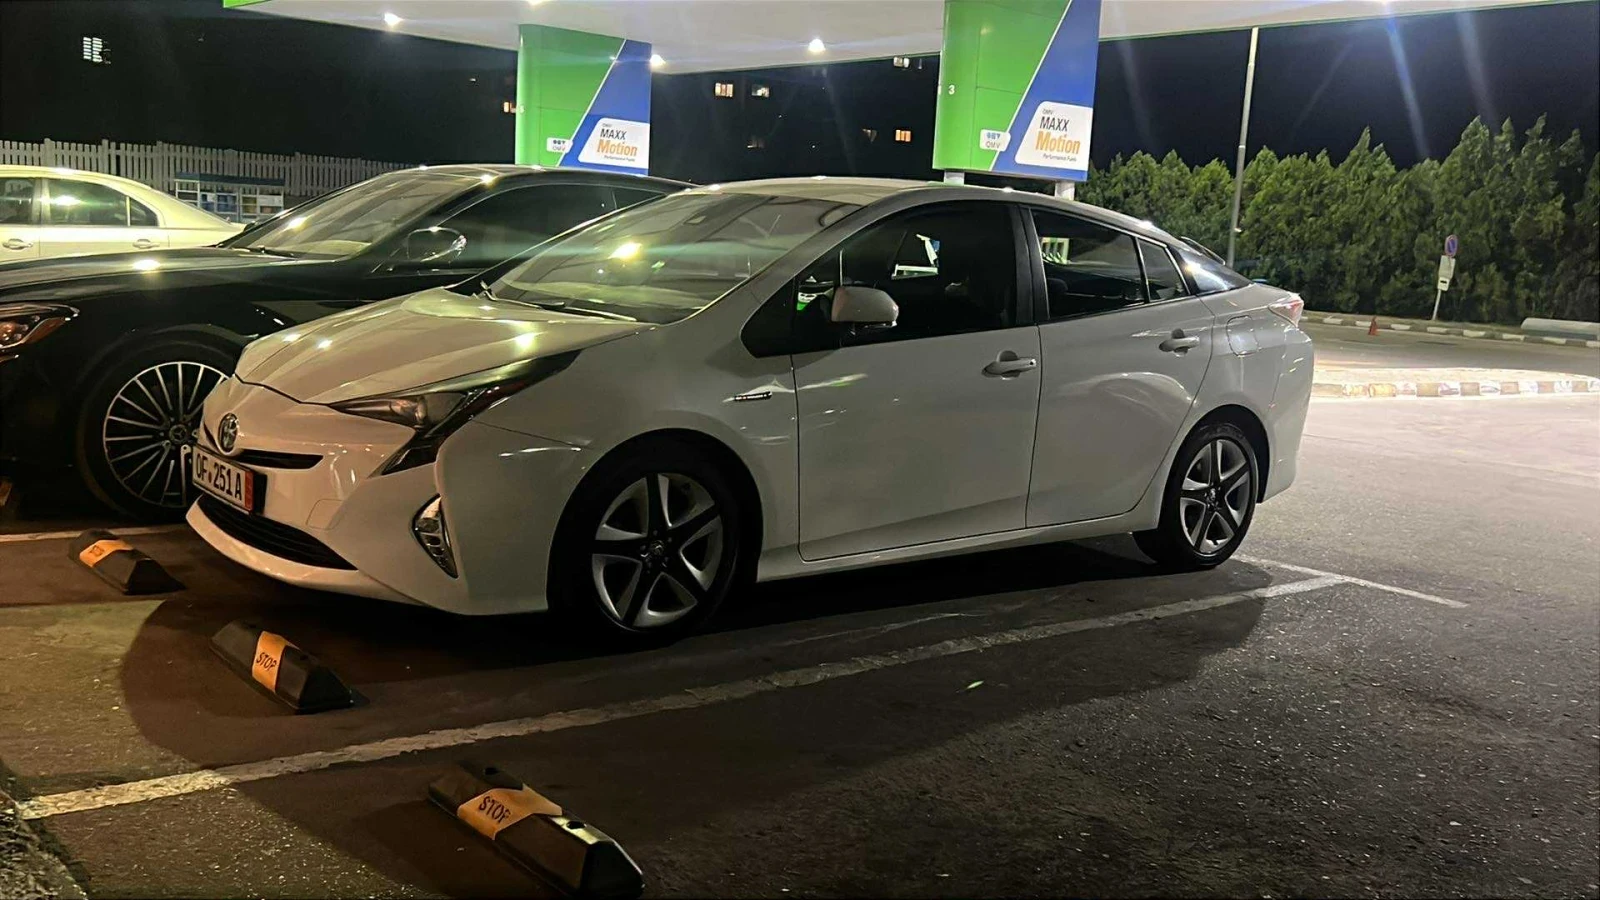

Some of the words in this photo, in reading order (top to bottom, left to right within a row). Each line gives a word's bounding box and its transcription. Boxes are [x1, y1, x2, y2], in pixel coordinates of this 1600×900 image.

[948, 84, 956, 95] 3
[1040, 116, 1069, 131] MAXX
[600, 128, 627, 140] MAXX
[598, 140, 637, 156] Motion
[1036, 131, 1081, 155] Motion
[196, 453, 208, 481] OF
[213, 462, 233, 496] 251
[235, 472, 242, 501] A
[256, 652, 277, 671] STOP
[479, 795, 511, 823] STOP
